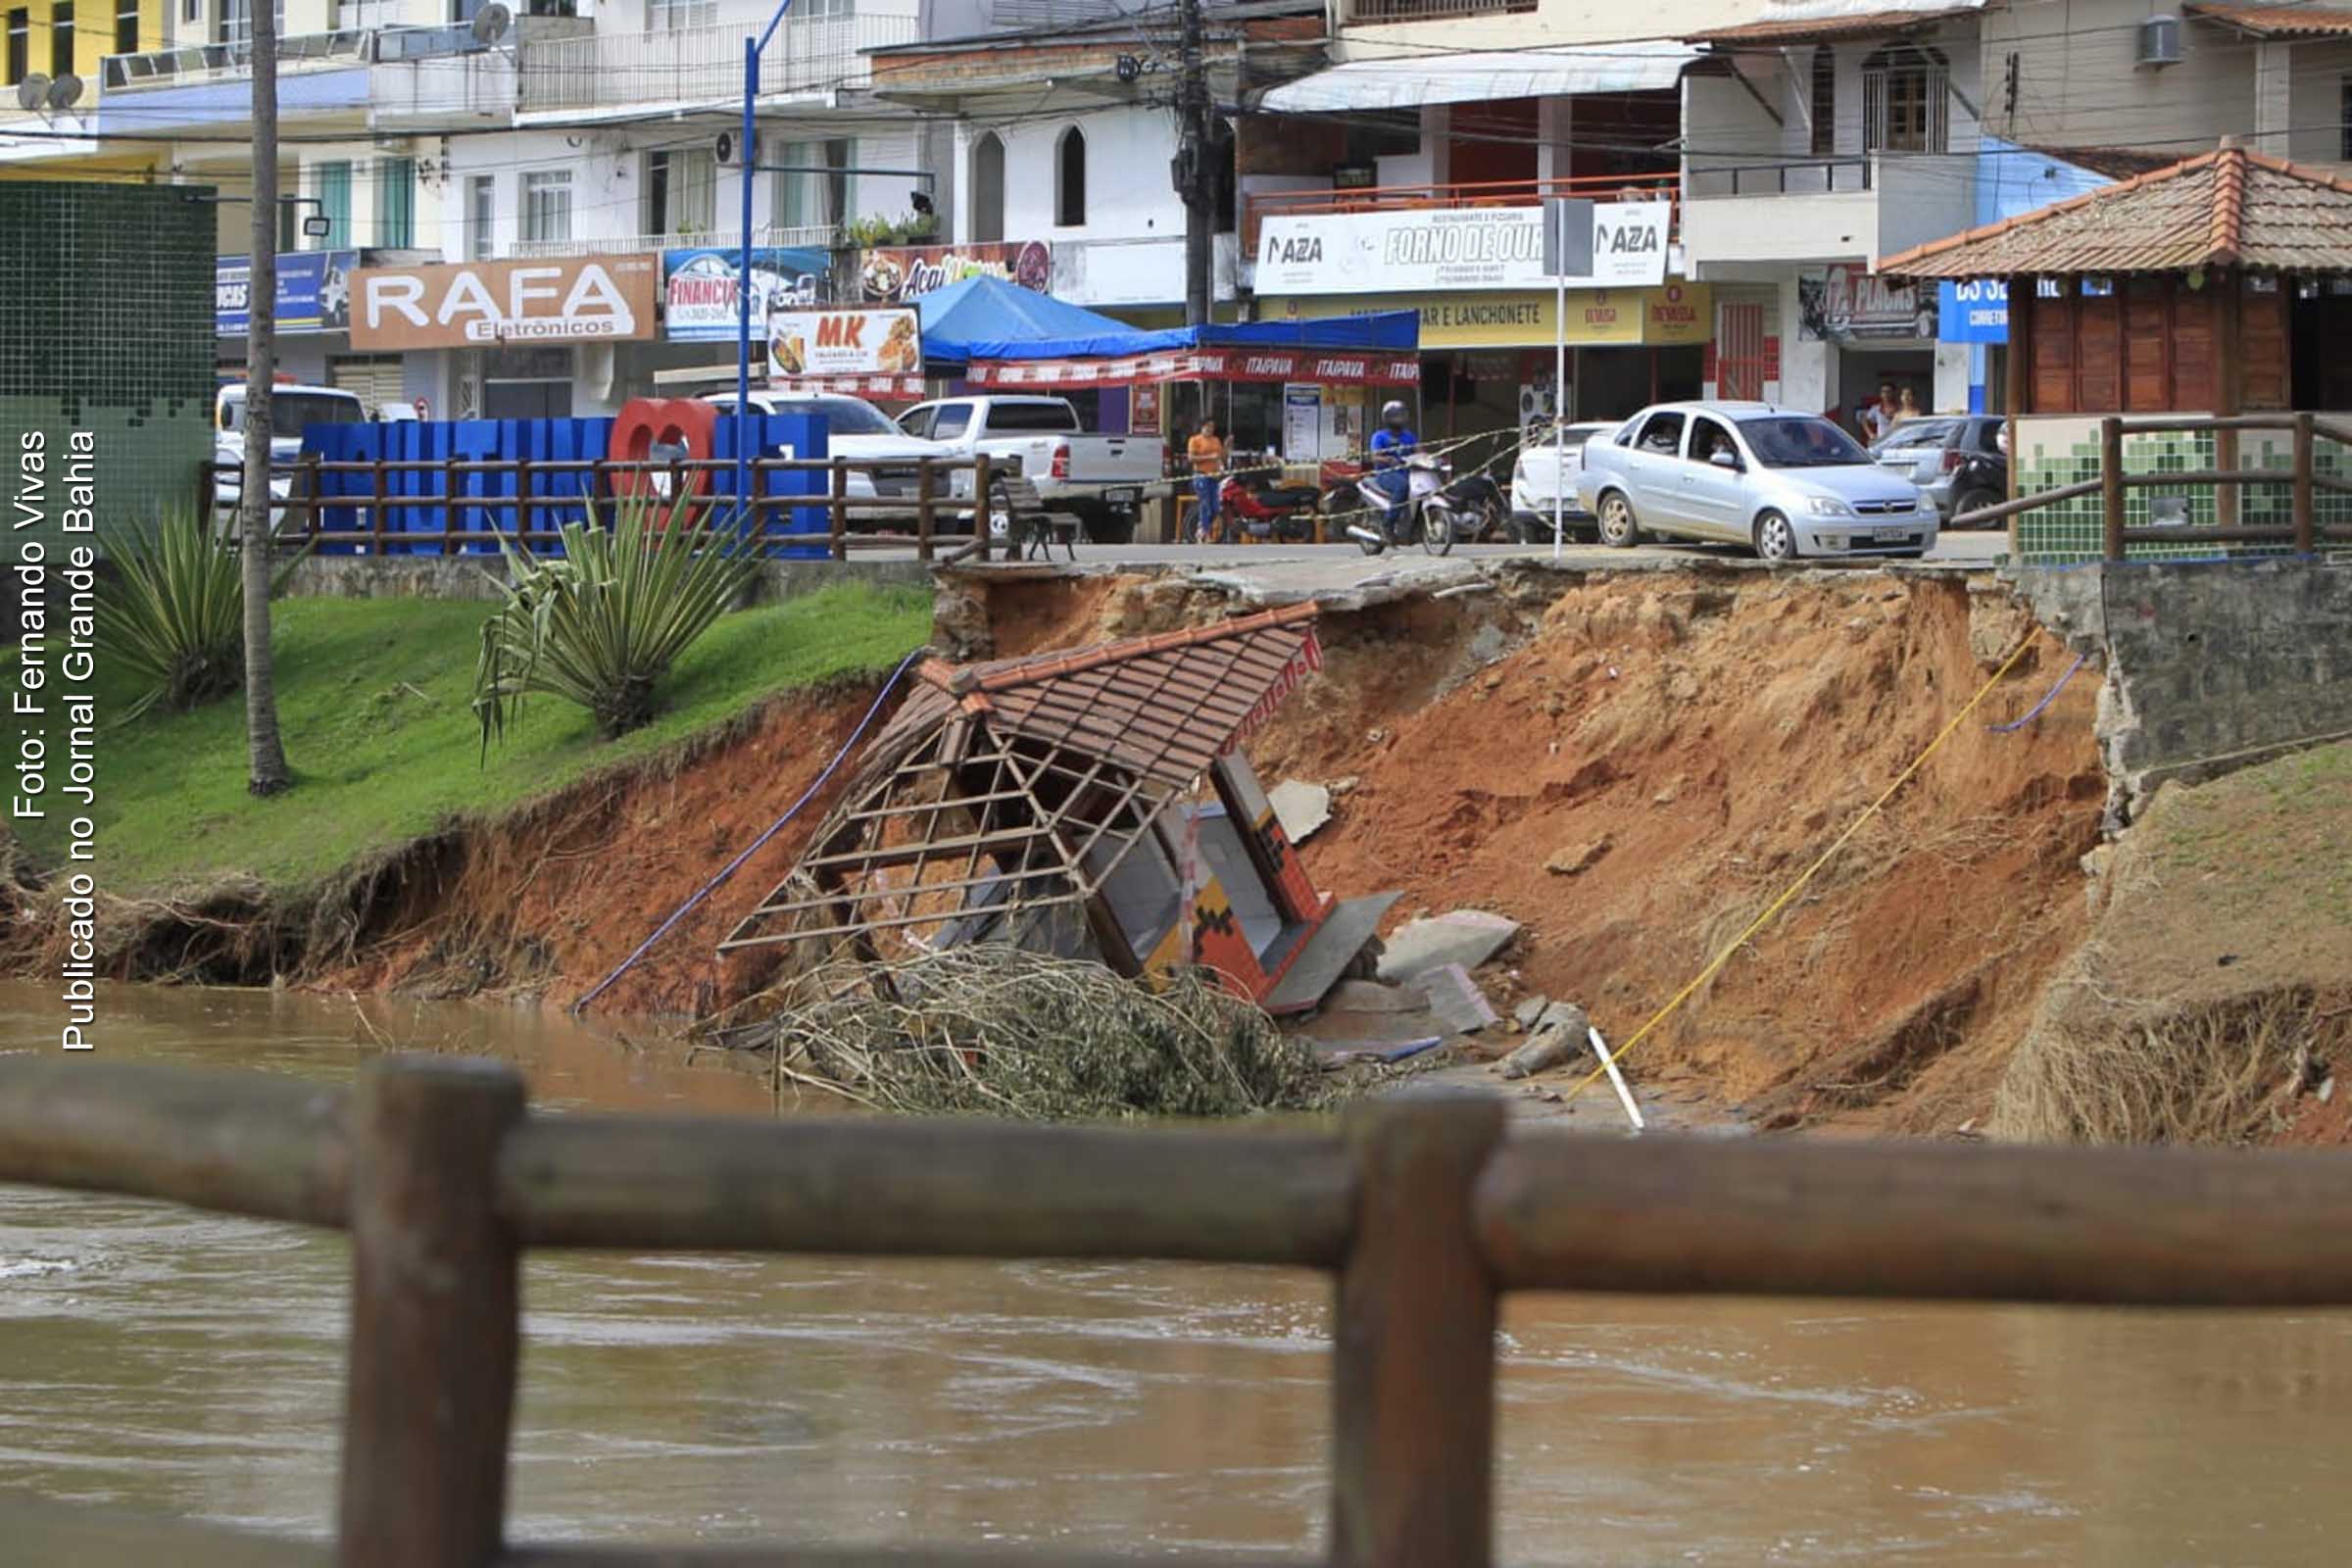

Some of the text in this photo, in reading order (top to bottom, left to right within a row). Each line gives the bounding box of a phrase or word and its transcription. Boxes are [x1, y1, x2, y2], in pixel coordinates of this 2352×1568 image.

[1384, 223, 1544, 266] FORNO DE OUR
[366, 263, 632, 328] RAFA
[815, 315, 867, 349] MK
[1421, 306, 1439, 326] AR
[1454, 304, 1541, 326] LANCHONETE
[1246, 357, 1293, 375] ITAIPAVA
[1316, 359, 1365, 377] ITAIPAVA
[1389, 361, 1420, 379] ITAIP
